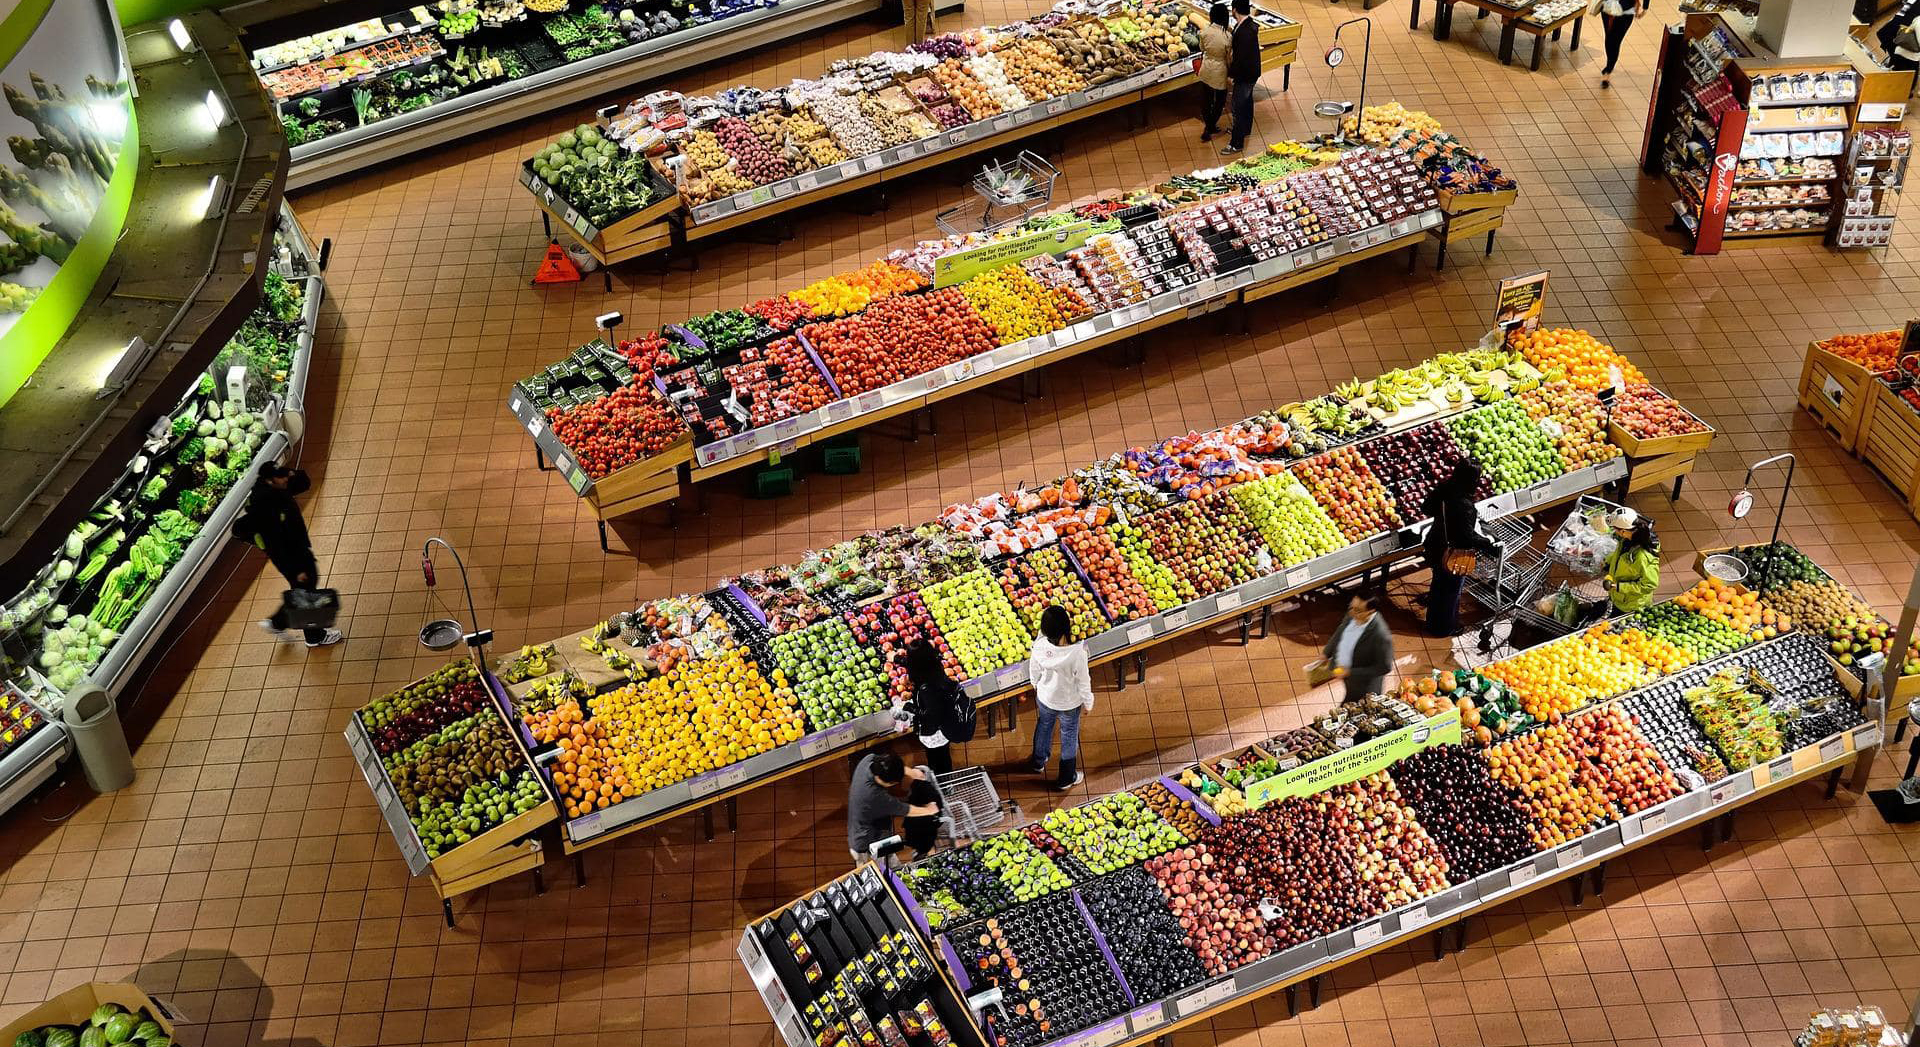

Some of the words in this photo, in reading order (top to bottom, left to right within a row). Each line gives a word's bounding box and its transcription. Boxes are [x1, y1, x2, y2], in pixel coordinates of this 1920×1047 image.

[1714, 153, 1736, 214] Vachon
[963, 250, 987, 261] Looking
[988, 248, 997, 256] for
[998, 242, 1026, 252] nutritious
[1028, 234, 1052, 245] choices?
[978, 254, 997, 264] Reach
[998, 251, 1007, 259] for
[1008, 248, 1018, 256] the
[1019, 244, 1038, 252] Stars!
[1286, 768, 1317, 785] Looking
[1319, 763, 1331, 772] for
[1333, 747, 1372, 767] nutritious
[1374, 733, 1408, 752] choices?
[1308, 771, 1333, 785] Reach
[1334, 766, 1346, 775] for
[1348, 760, 1362, 770] the
[1363, 749, 1387, 764] Stars!
